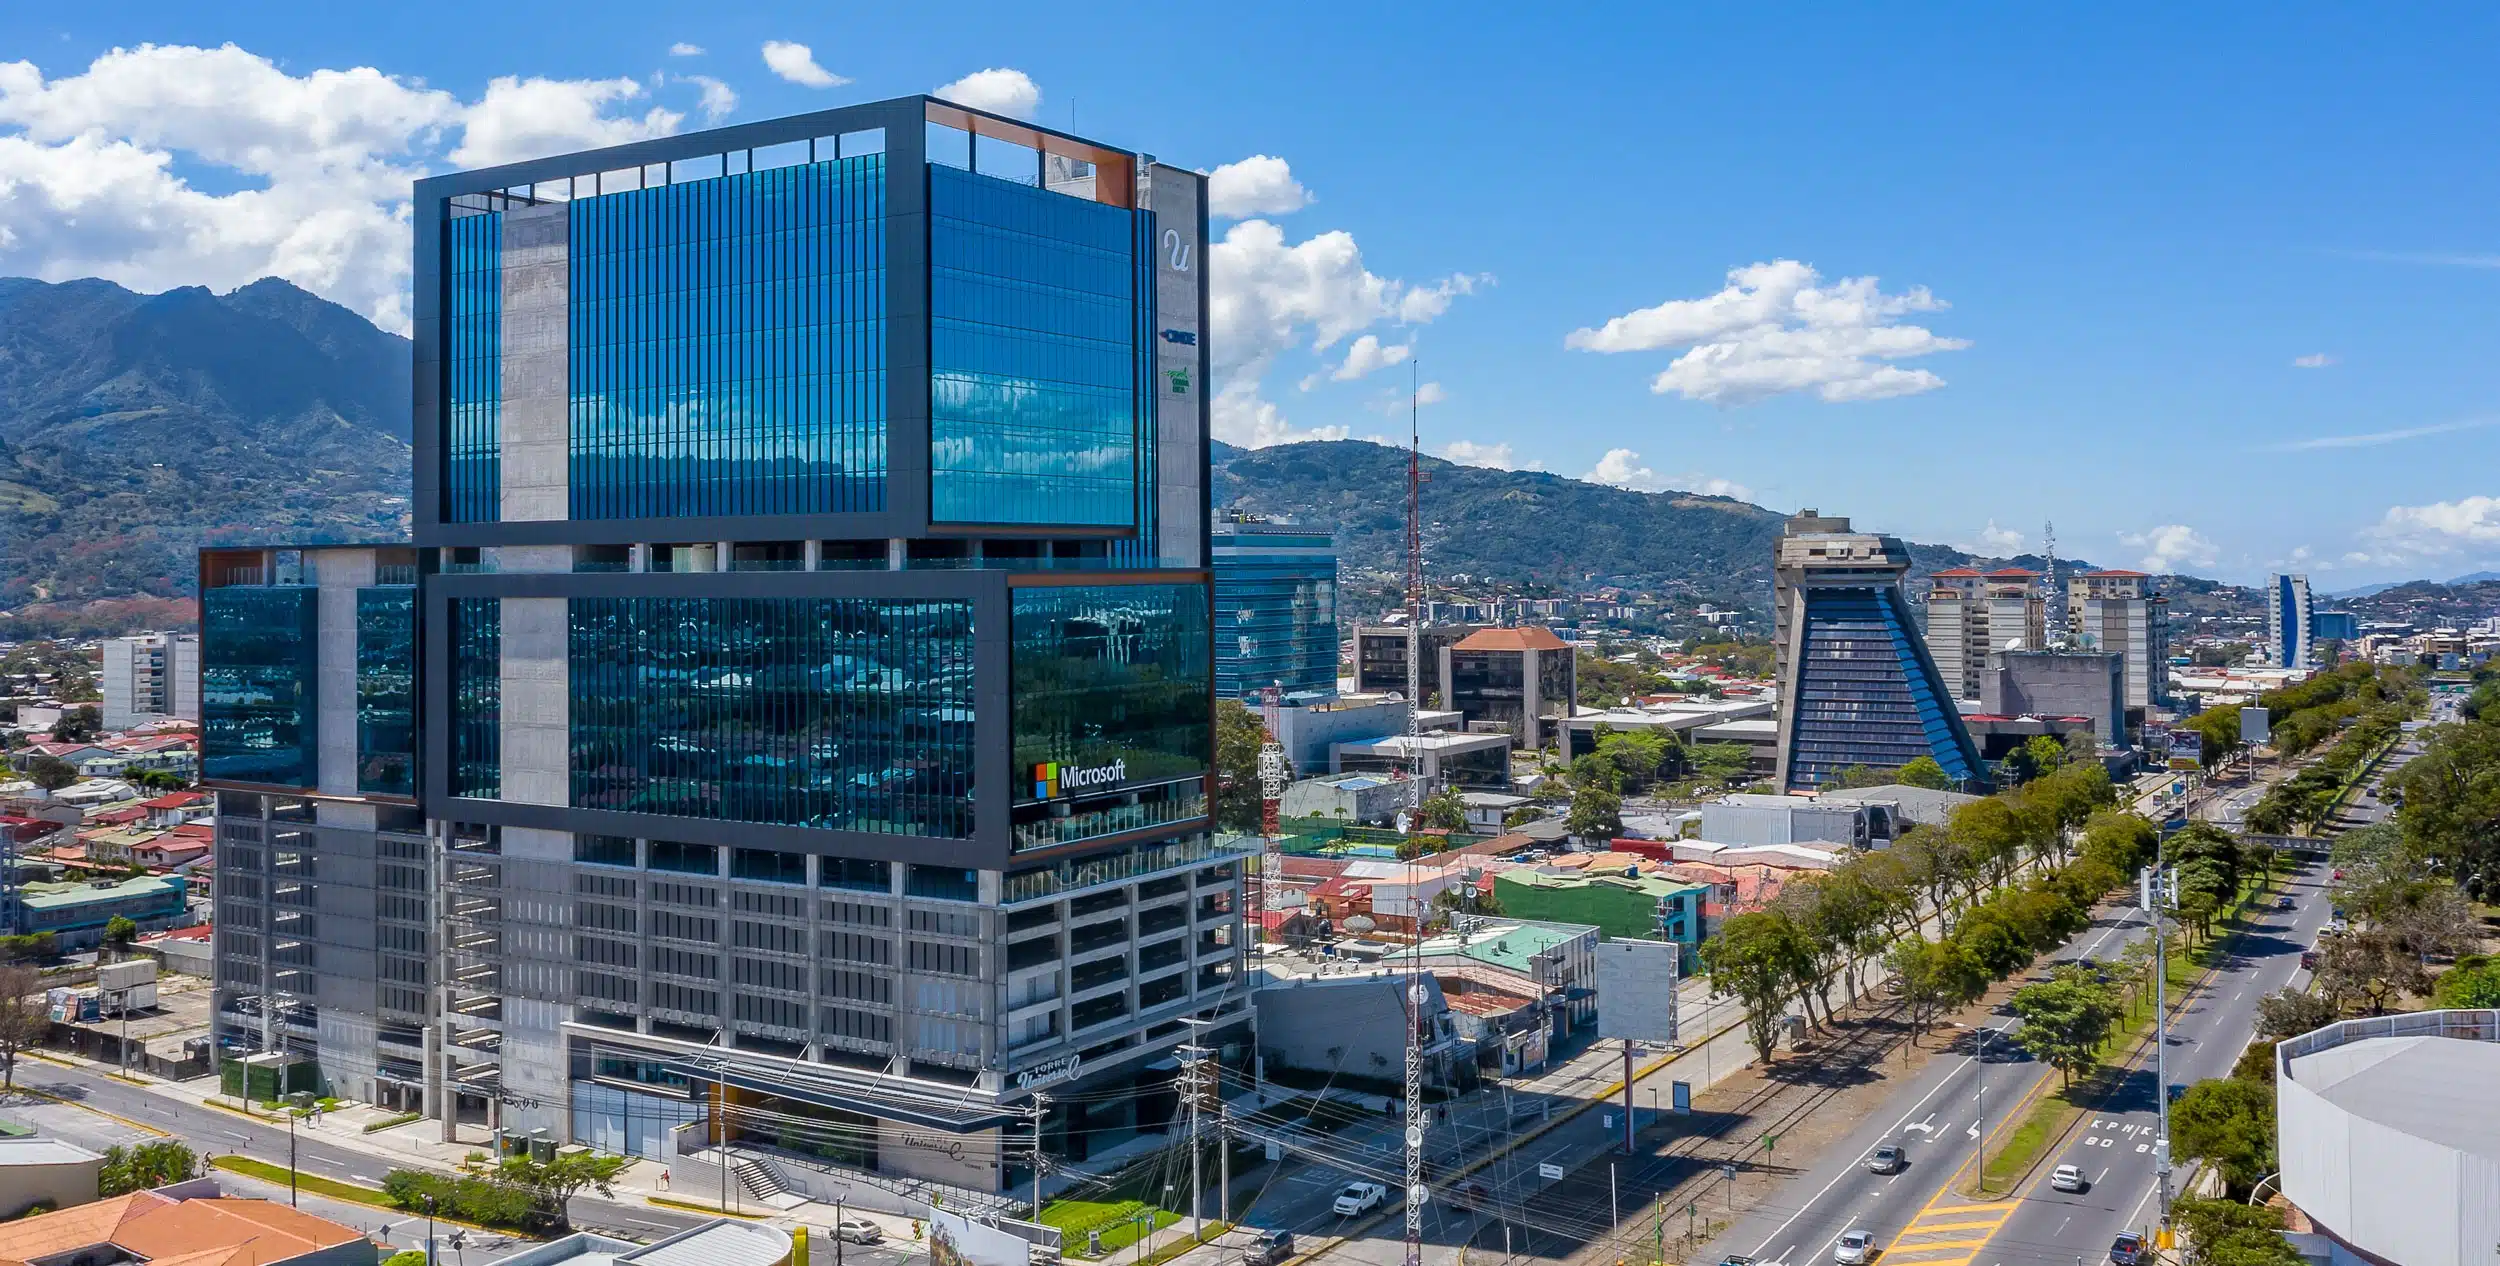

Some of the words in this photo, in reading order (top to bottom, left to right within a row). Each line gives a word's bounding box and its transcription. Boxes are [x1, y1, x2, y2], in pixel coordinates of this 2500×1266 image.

[1061, 758, 1126, 789] Microsoft
[1016, 1054, 1084, 1091] Universal
[1034, 1057, 1067, 1074] TORRE
[2084, 1136, 2114, 1148] 80
